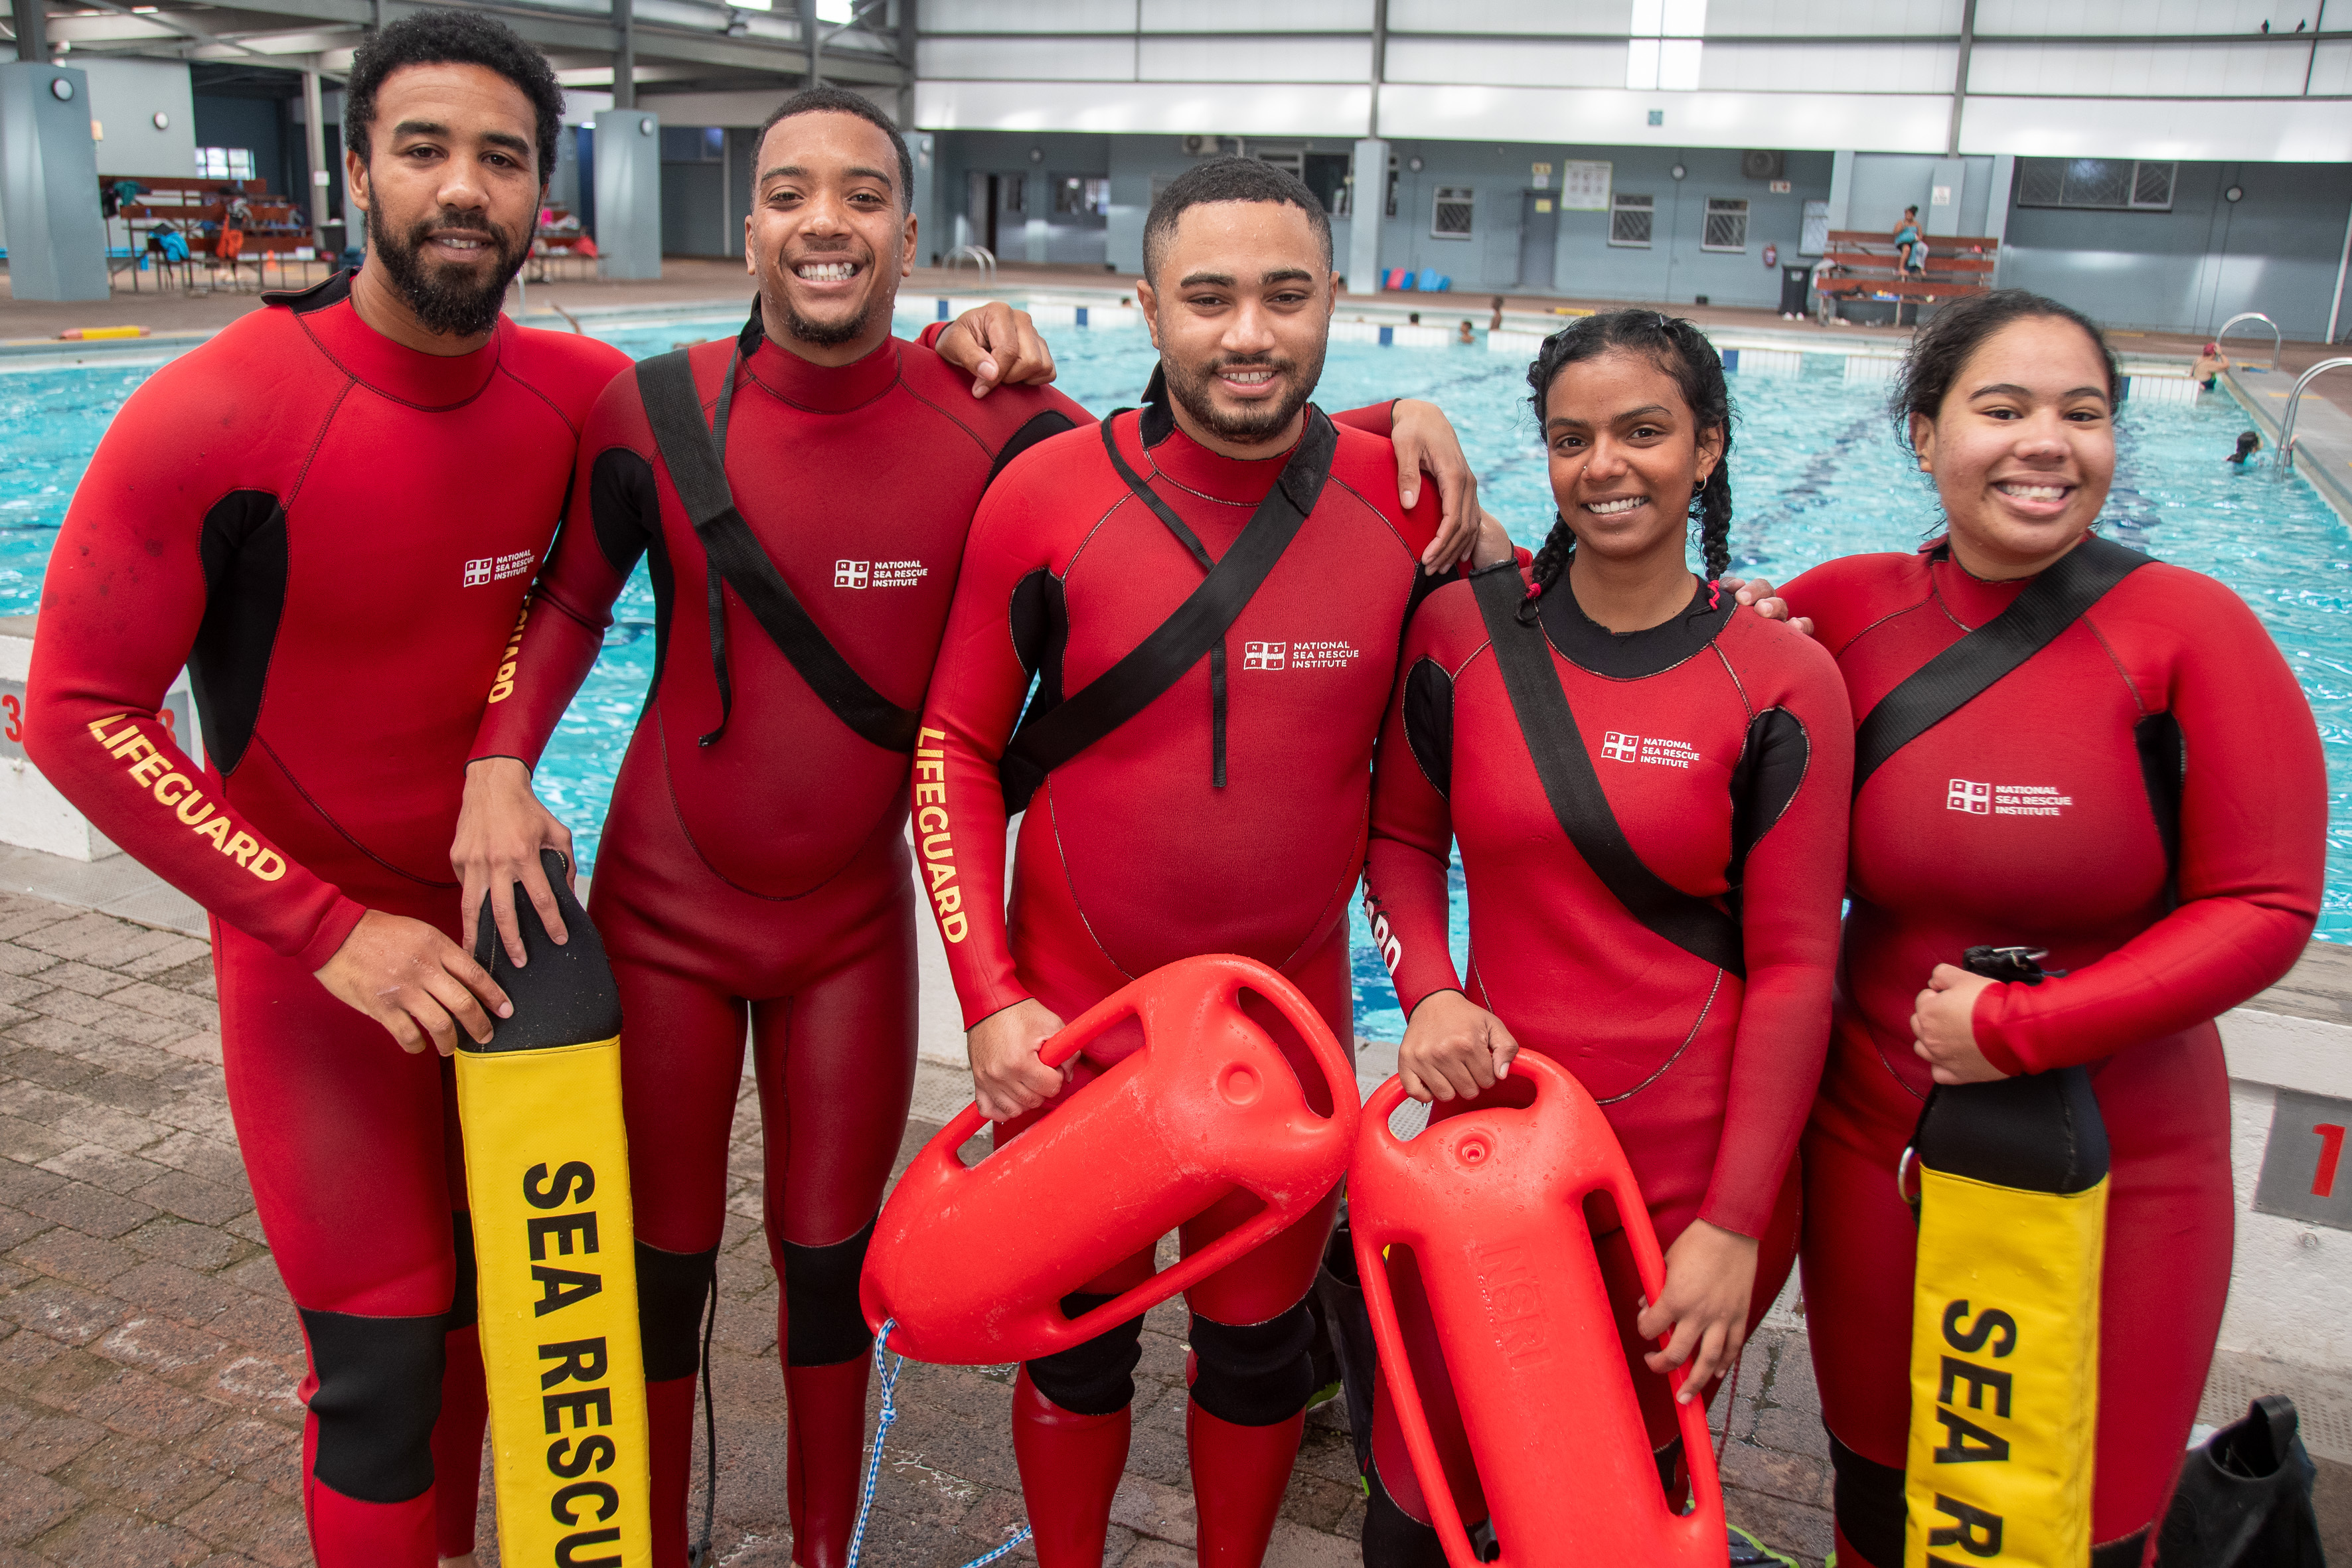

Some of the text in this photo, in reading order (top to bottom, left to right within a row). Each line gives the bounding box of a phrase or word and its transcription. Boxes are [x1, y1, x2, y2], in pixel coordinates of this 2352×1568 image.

[497, 549, 531, 564] NATIONAL
[511, 555, 535, 569] RESCUE
[874, 560, 921, 570] NATIONAL
[494, 566, 528, 580] INSTITUTE
[894, 568, 928, 578] RESCUE
[872, 578, 918, 587] INSTITUTE
[1294, 641, 1350, 650] NATIONAL
[1318, 650, 1359, 659] RESCUE
[2, 694, 23, 742] 3
[1643, 738, 1692, 750] NATIONAL
[1640, 755, 1689, 768] INSTITUTE
[1663, 749, 1700, 761] RESCUE
[1995, 785, 2060, 795] NATIONAL
[88, 713, 286, 882] LIFEGUARD
[2022, 797, 2073, 805] RESCUE
[1995, 806, 2061, 815] INSTITUTE
[916, 726, 968, 944] LIFEGUARD
[2310, 1123, 2347, 1198] 1
[522, 1160, 602, 1318] SEA
[1480, 1245, 1553, 1370] NSRI
[1925, 1298, 2017, 1568] SEA R
